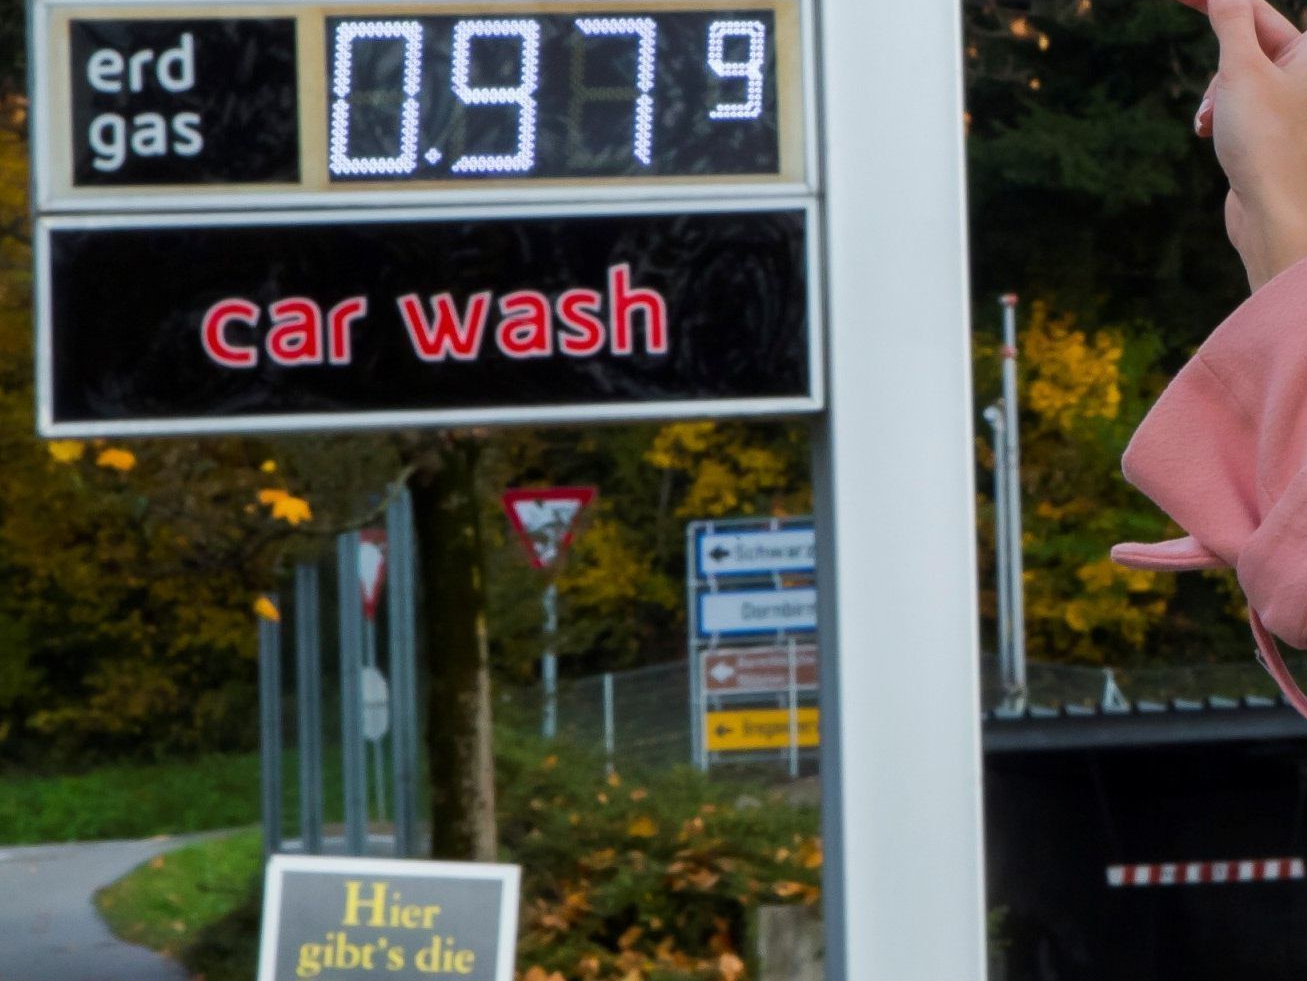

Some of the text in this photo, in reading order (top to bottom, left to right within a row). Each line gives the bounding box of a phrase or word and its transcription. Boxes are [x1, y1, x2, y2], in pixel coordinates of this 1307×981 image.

[87, 33, 195, 92] erd
[89, 111, 203, 171] gas
[201, 262, 668, 368] car wash
[341, 879, 442, 929] Hier
[295, 931, 476, 978] gibt's die
